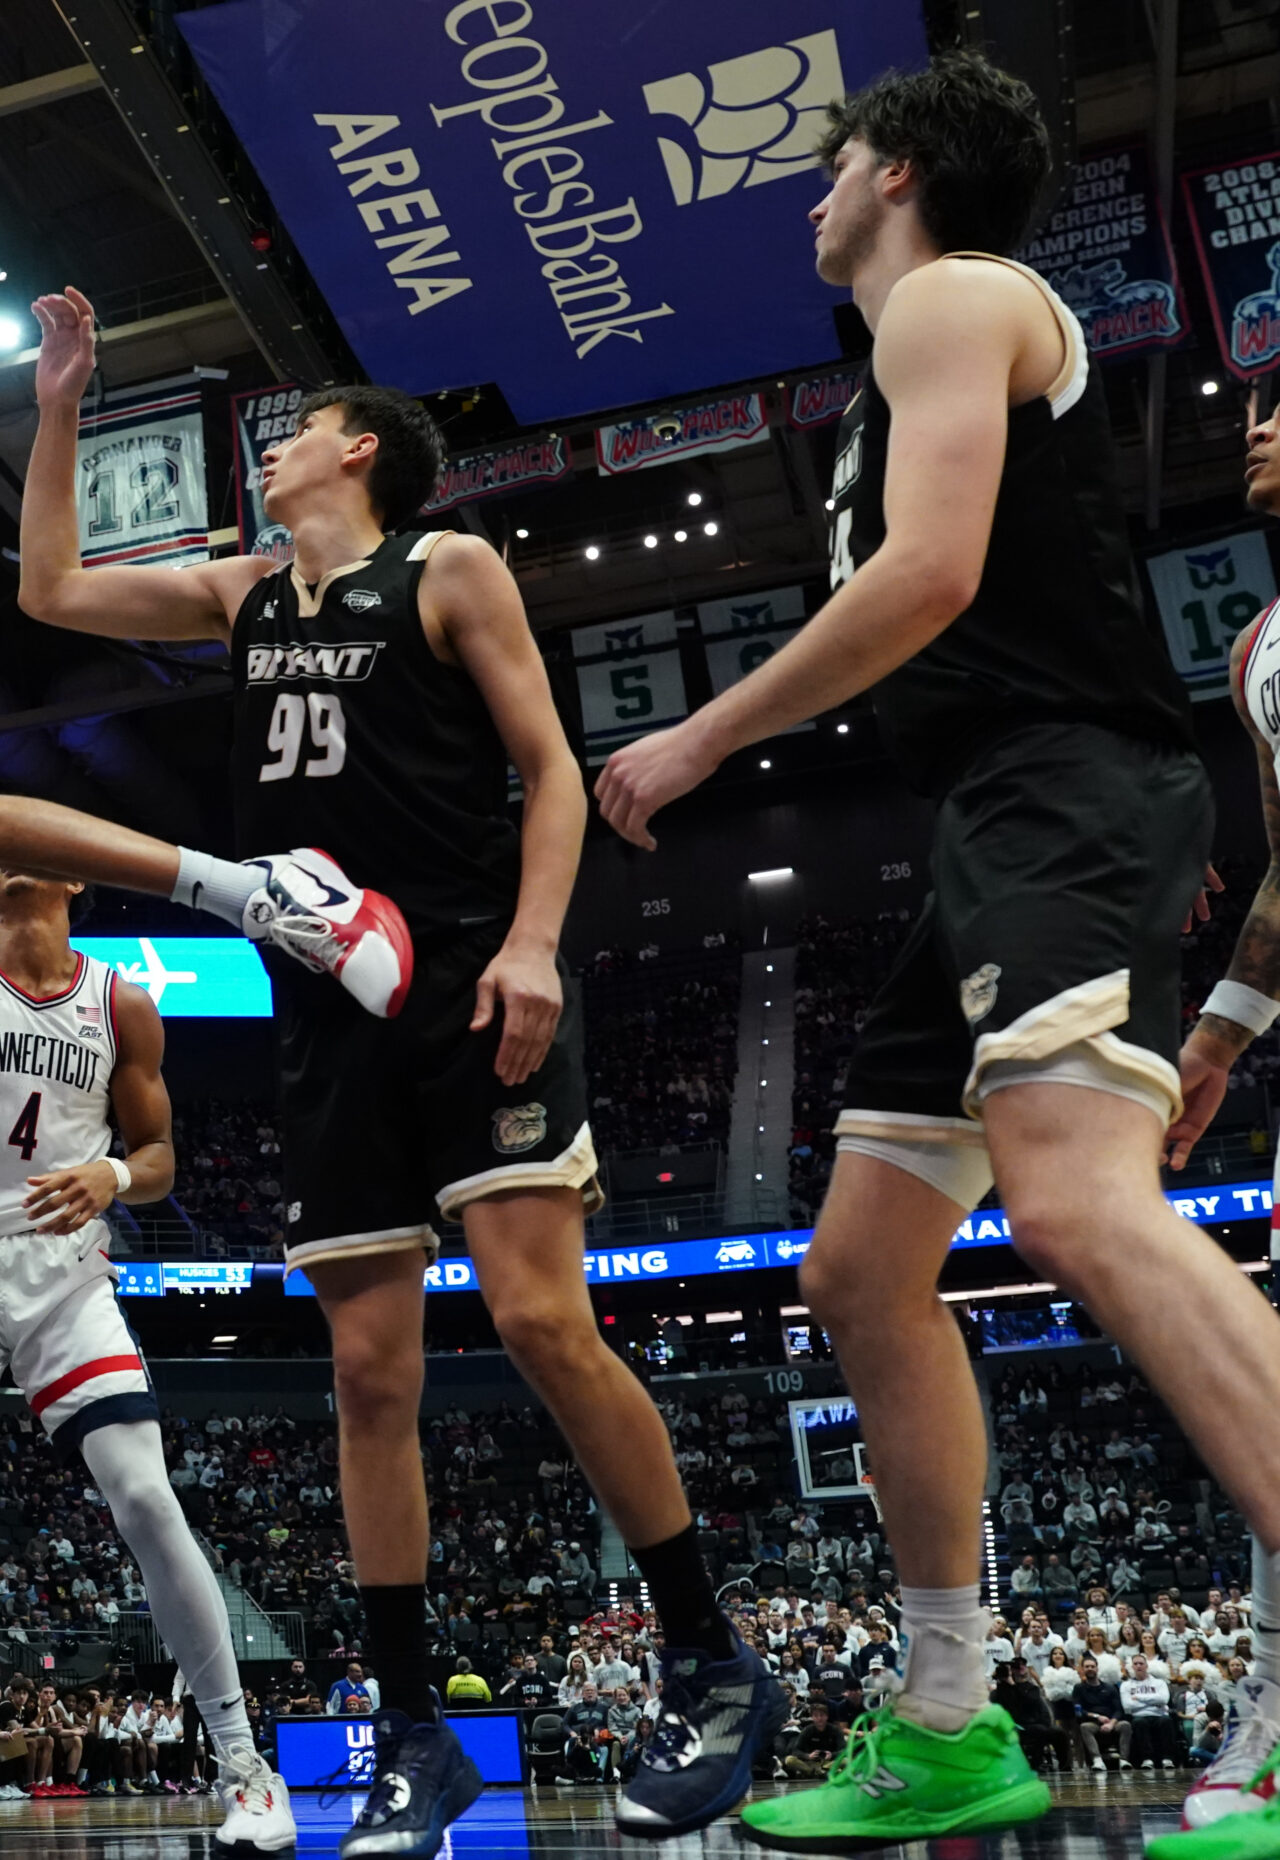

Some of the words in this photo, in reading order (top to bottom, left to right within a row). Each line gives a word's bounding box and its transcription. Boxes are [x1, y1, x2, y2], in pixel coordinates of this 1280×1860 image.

[430, 0, 676, 360] eoplesBank
[312, 113, 473, 316] ARENA
[1050, 193, 1146, 232] ERENCE
[1012, 216, 1147, 262] HAMPIONS
[682, 398, 750, 439] PACK
[492, 442, 556, 482] PACK
[88, 457, 180, 537] 12
[1181, 591, 1264, 663] 19
[248, 647, 373, 681] BRYANT
[609, 664, 654, 720] 5
[259, 692, 347, 783] 99
[881, 862, 912, 881] 236
[642, 899, 670, 917] 235
[7, 1091, 43, 1161] 4
[225, 1267, 246, 1283] 53
[423, 1263, 471, 1287] RD
[763, 1369, 803, 1394] 109
[348, 1751, 376, 1773] 97
